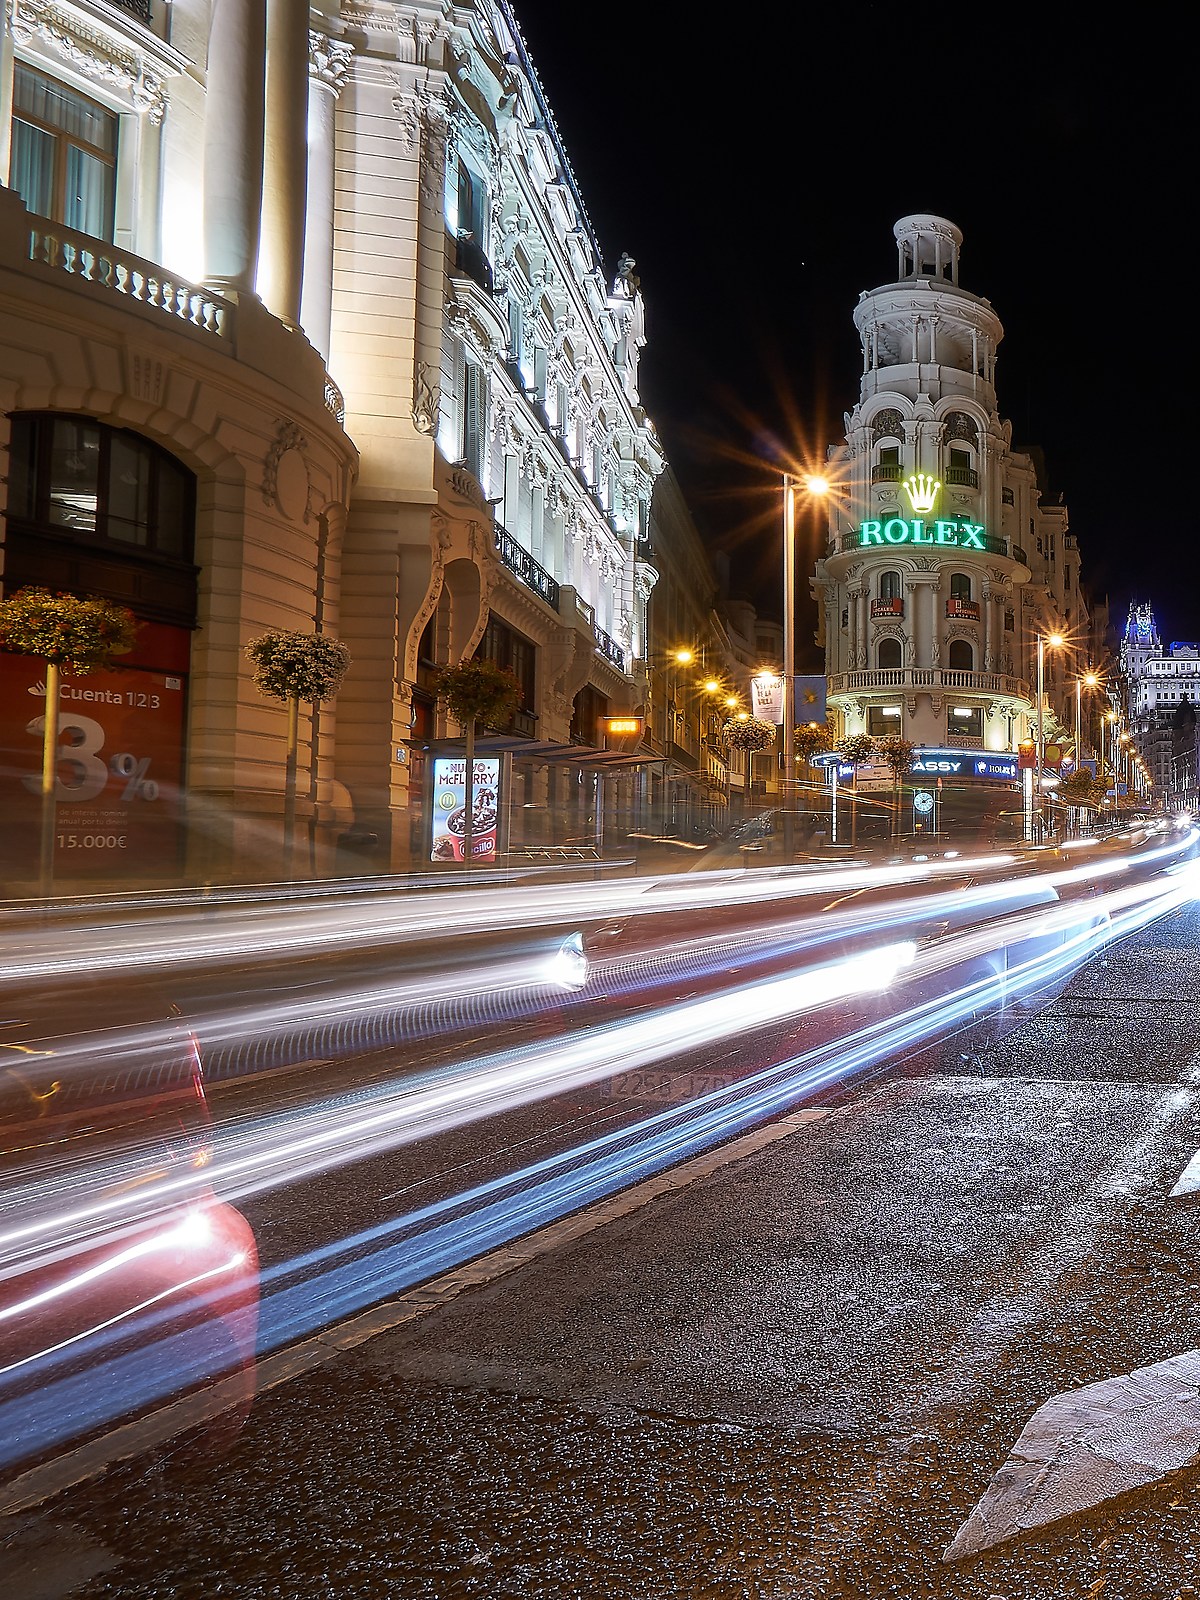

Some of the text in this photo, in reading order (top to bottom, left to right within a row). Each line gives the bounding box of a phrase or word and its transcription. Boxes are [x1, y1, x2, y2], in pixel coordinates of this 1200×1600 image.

[860, 518, 986, 549] ROLEX
[59, 684, 123, 705] Cuenta
[449, 763, 486, 773] NUO
[912, 761, 962, 772] ASSY
[439, 773, 496, 785] McFLRRY
[57, 835, 127, 848] 15.000€
[462, 841, 493, 854] cilla
